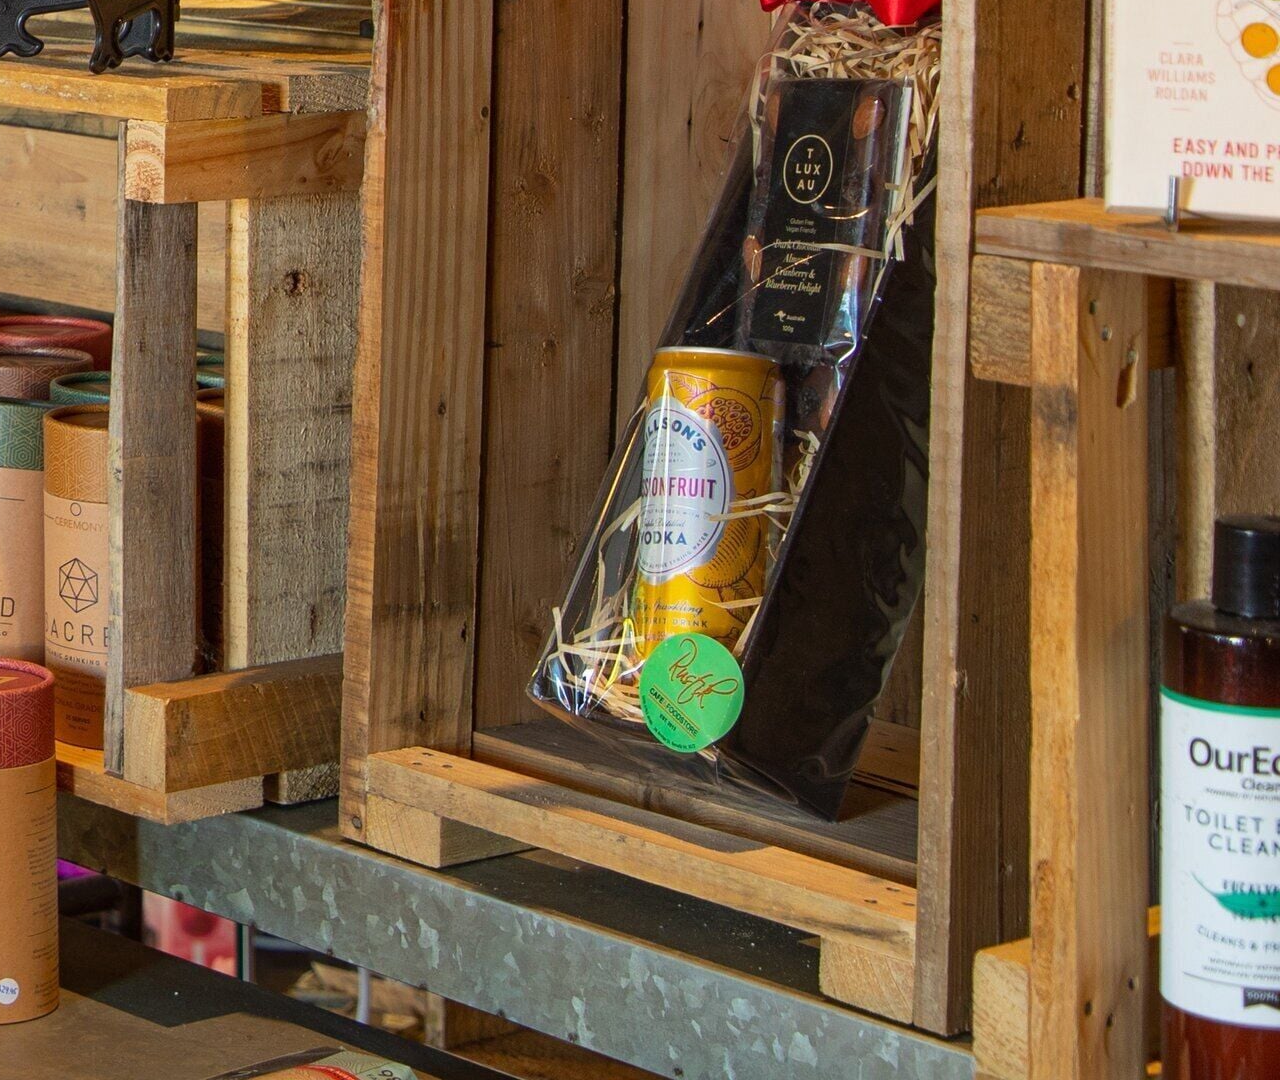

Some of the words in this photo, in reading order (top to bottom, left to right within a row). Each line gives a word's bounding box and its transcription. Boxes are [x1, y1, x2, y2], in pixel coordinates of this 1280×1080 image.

[1160, 52, 1203, 66] CLARA
[1147, 69, 1216, 84] WILLIAMS
[1156, 86, 1208, 101] ROLDAN
[1173, 137, 1217, 155] EASY
[1224, 141, 1259, 159] AND
[795, 163, 821, 175] LUX
[1182, 161, 1233, 179] DOWN
[1241, 164, 1274, 182] THE
[796, 179, 815, 191] AU
[786, 226, 799, 234] Vegan
[800, 226, 817, 235] Friendly
[775, 266, 808, 281] Cranberry
[765, 279, 798, 294] Blueberry
[798, 282, 822, 294] Delight
[54, 516, 104, 532] CEREMONY
[672, 618, 708, 628] DRINK
[65, 654, 100, 667] DRINKING
[1184, 804, 1263, 834] TOILET
[1197, 923, 1245, 950] CLEANS
